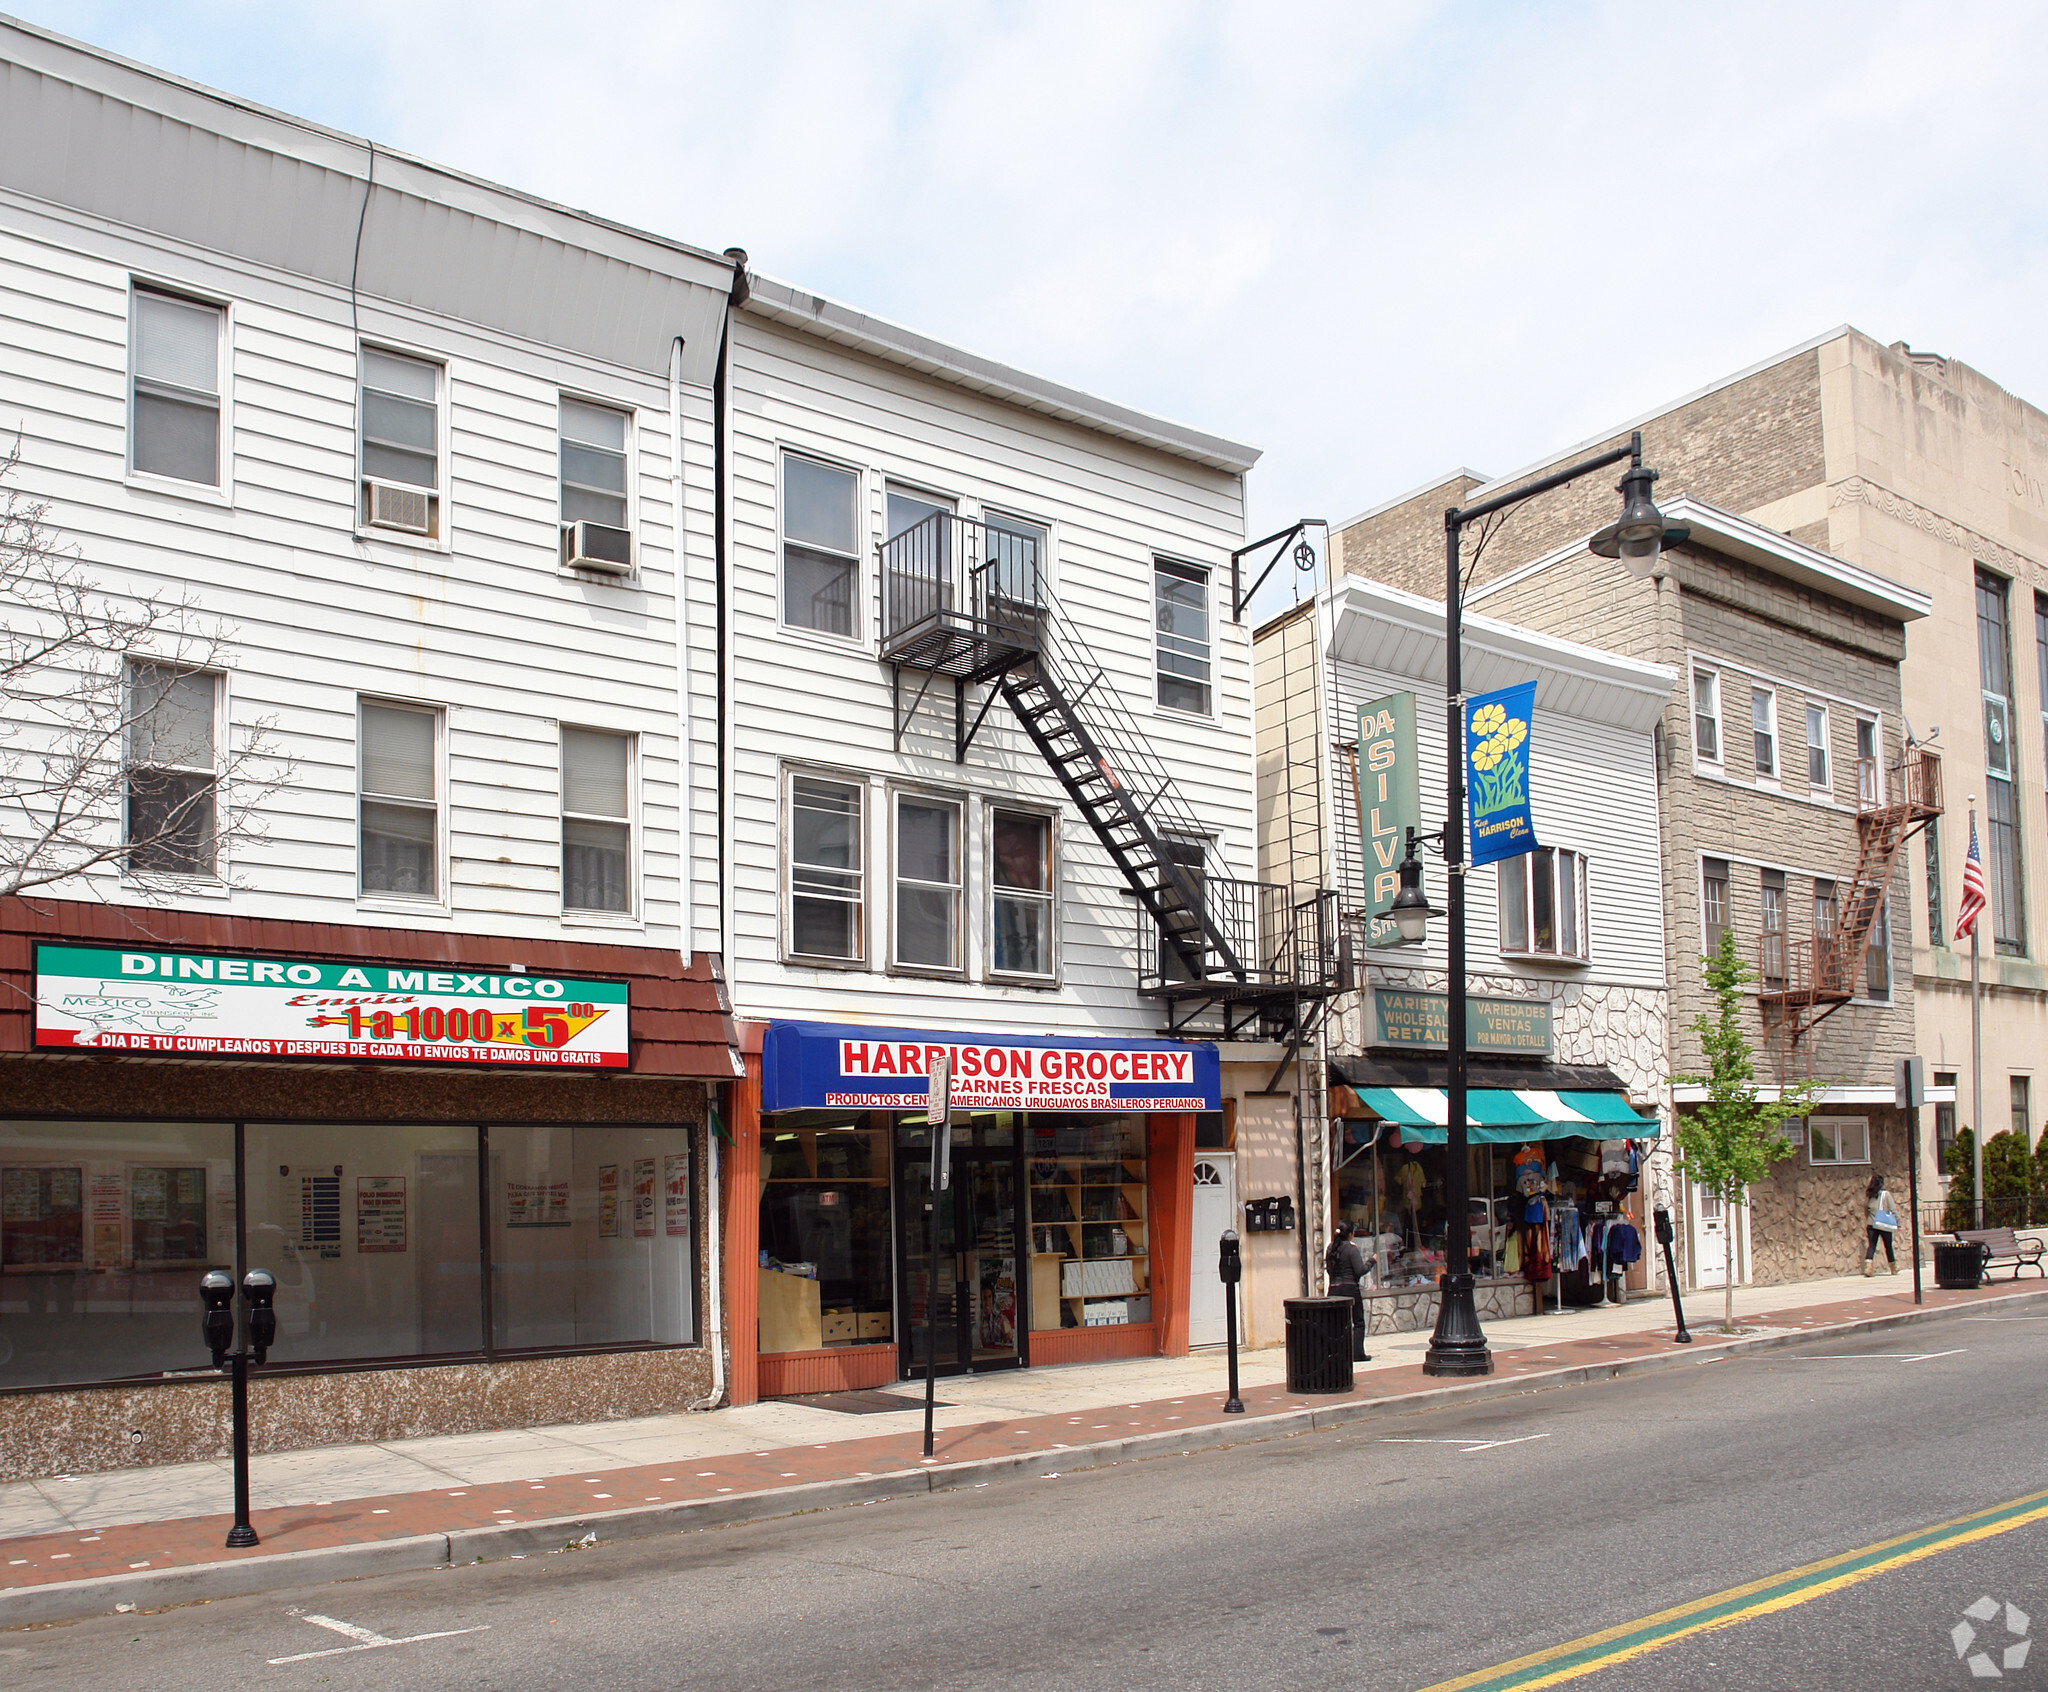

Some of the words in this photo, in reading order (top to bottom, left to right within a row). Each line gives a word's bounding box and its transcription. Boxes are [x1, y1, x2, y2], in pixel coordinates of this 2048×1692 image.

[1361, 709, 1395, 741] DA
[1368, 739, 1401, 903] SILVA
[1479, 816, 1524, 838] HARRISON
[121, 953, 321, 984] DINERO
[337, 968, 372, 988] A
[387, 970, 564, 998] MEXICO
[62, 996, 152, 1009] MEXICO
[1383, 994, 1448, 1012] VARIETY
[1477, 1002, 1546, 1018] VARIEDADES
[1384, 1011, 1449, 1028] WHOLESAL
[1487, 1018, 1532, 1032] VENTAS
[1387, 1026, 1449, 1043] RETAIL
[1477, 1032, 1490, 1045] POR
[1490, 1032, 1512, 1046] MAYOR
[1517, 1034, 1546, 1047] DETALLE
[101, 1034, 127, 1048] DIA
[133, 1035, 150, 1049] DE
[153, 1036, 173, 1050] TU
[177, 1037, 271, 1053] CUMPLEAÑOS
[274, 1041, 283, 1053] Y
[287, 1041, 347, 1055] DESPUES
[350, 1043, 367, 1055] DE
[370, 1044, 404, 1057] CADA
[407, 1045, 421, 1057] 10
[424, 1046, 469, 1058] ENVIOS
[472, 1047, 488, 1060] TE
[490, 1049, 531, 1061] DAMOS
[534, 1050, 558, 1063] UNO
[561, 1051, 601, 1064] GRATIS
[1040, 1050, 1188, 1081] GROCERY
[951, 1079, 1023, 1095] CARNES
[1028, 1081, 1107, 1095] FRESCAS
[827, 1093, 900, 1106] PRODUCTOS
[1026, 1096, 1088, 1109] URUGUAYOS
[1091, 1098, 1151, 1110] BRASILEROS
[1153, 1098, 1204, 1110] PERUANOS
[821, 1194, 835, 1203] ATM
